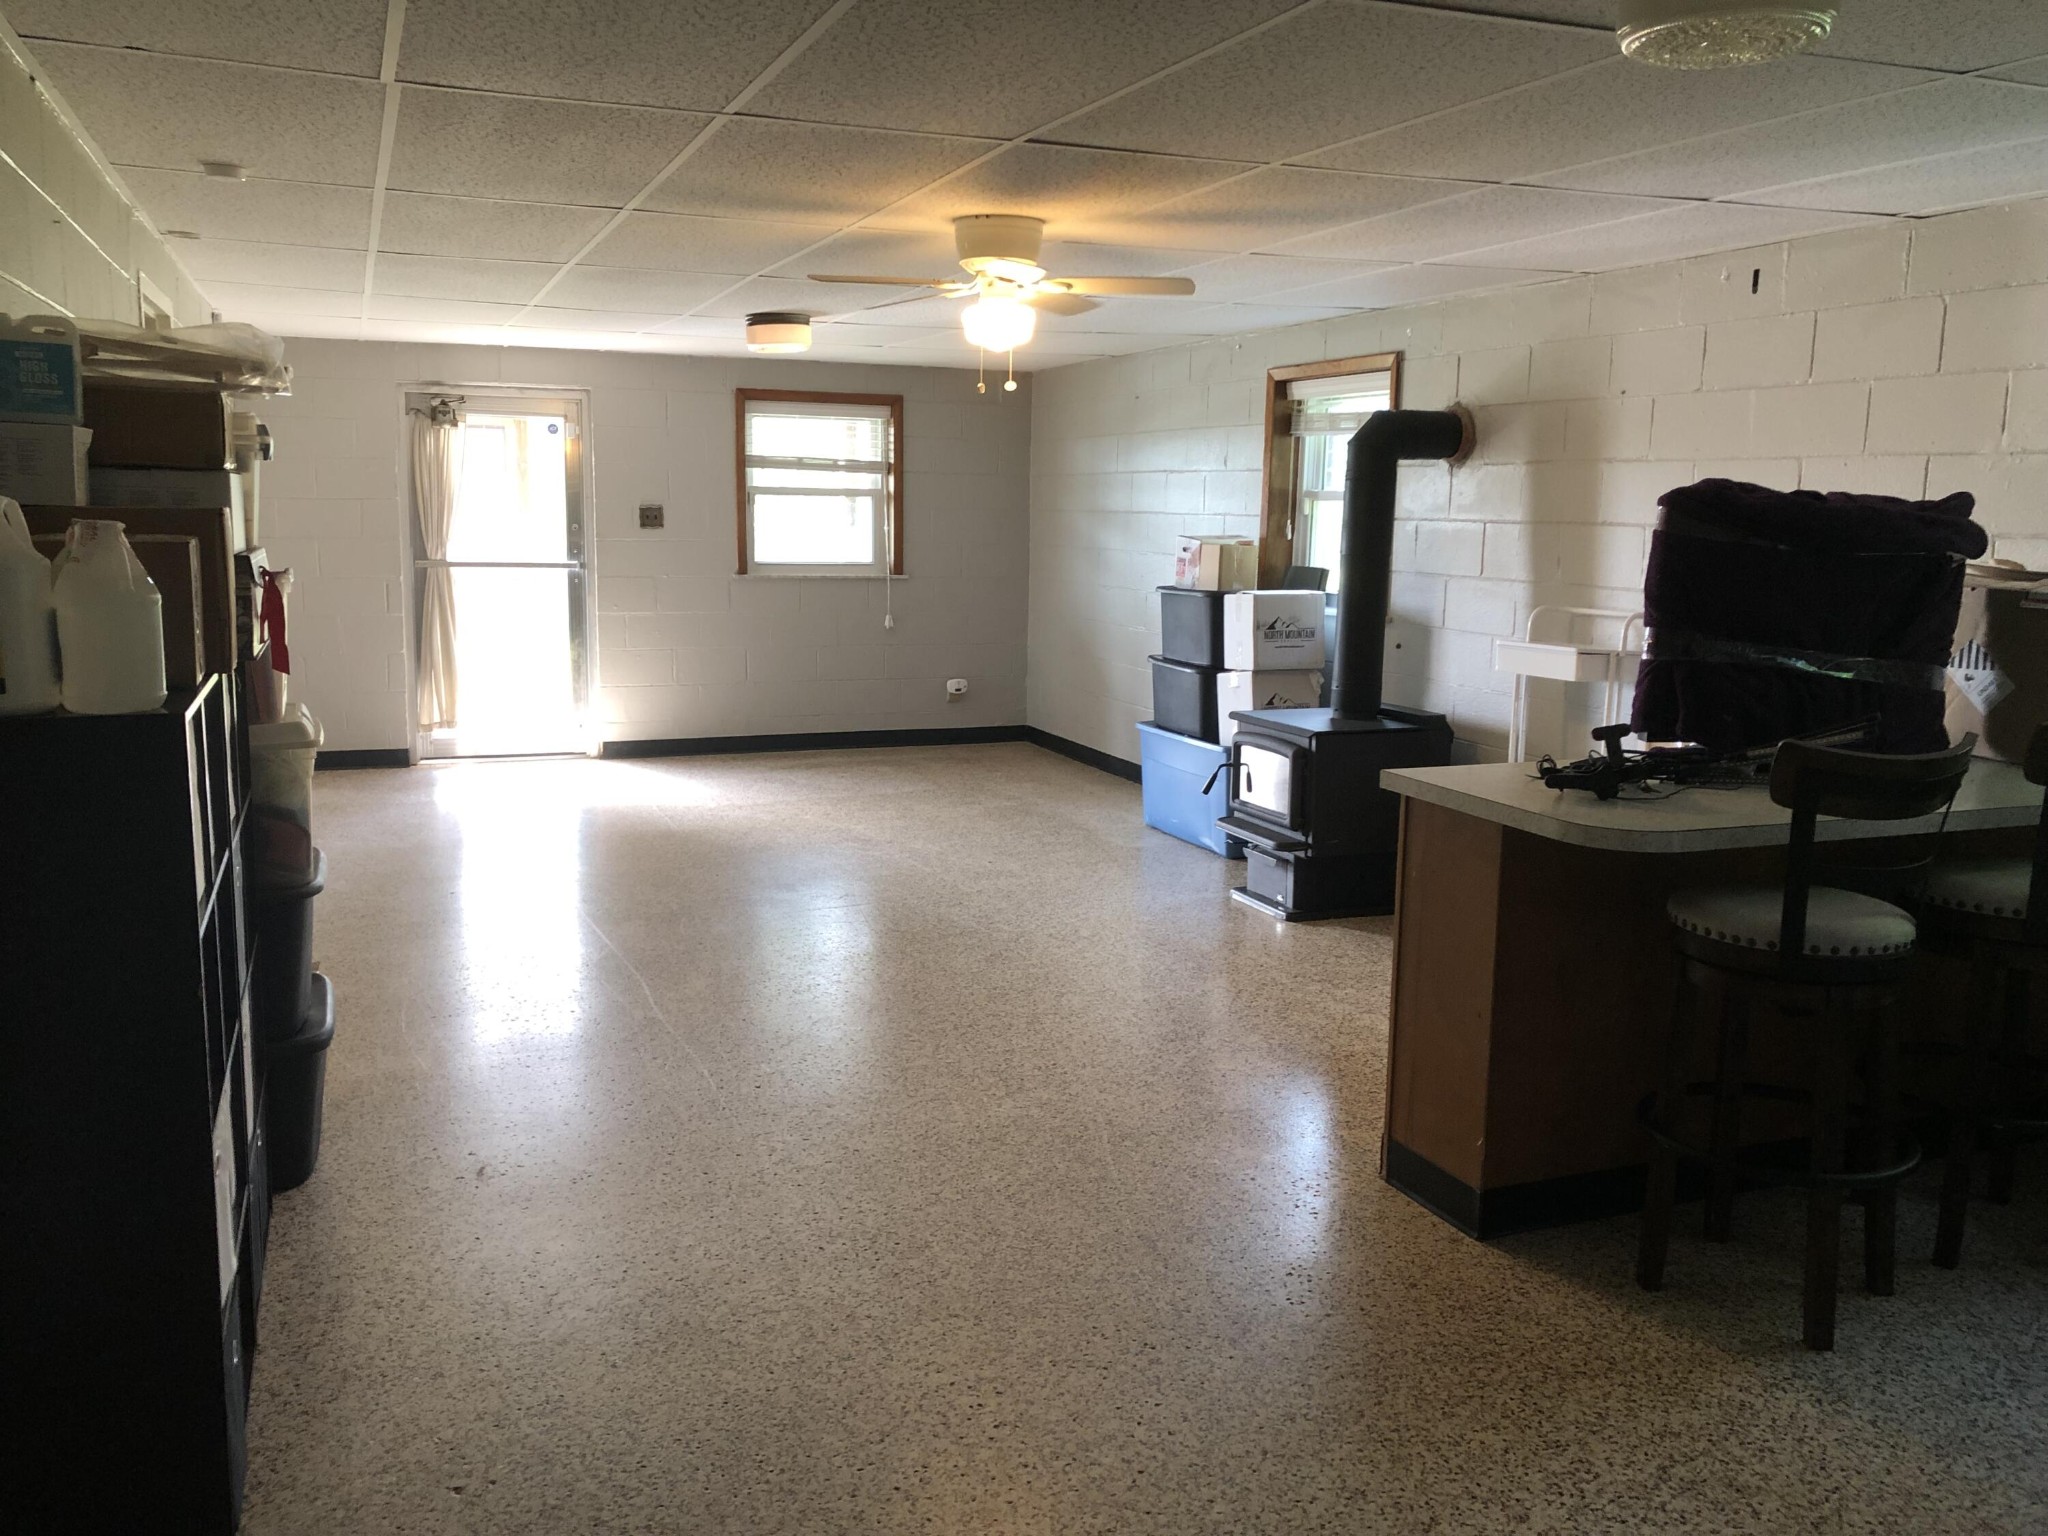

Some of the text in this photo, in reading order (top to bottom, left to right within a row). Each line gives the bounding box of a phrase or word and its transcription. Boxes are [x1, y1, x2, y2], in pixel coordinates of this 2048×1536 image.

[19, 360, 49, 372] HIGH
[19, 371, 59, 385] GLOSS
[1264, 629, 1316, 640] NORTH MOUNTAIN
